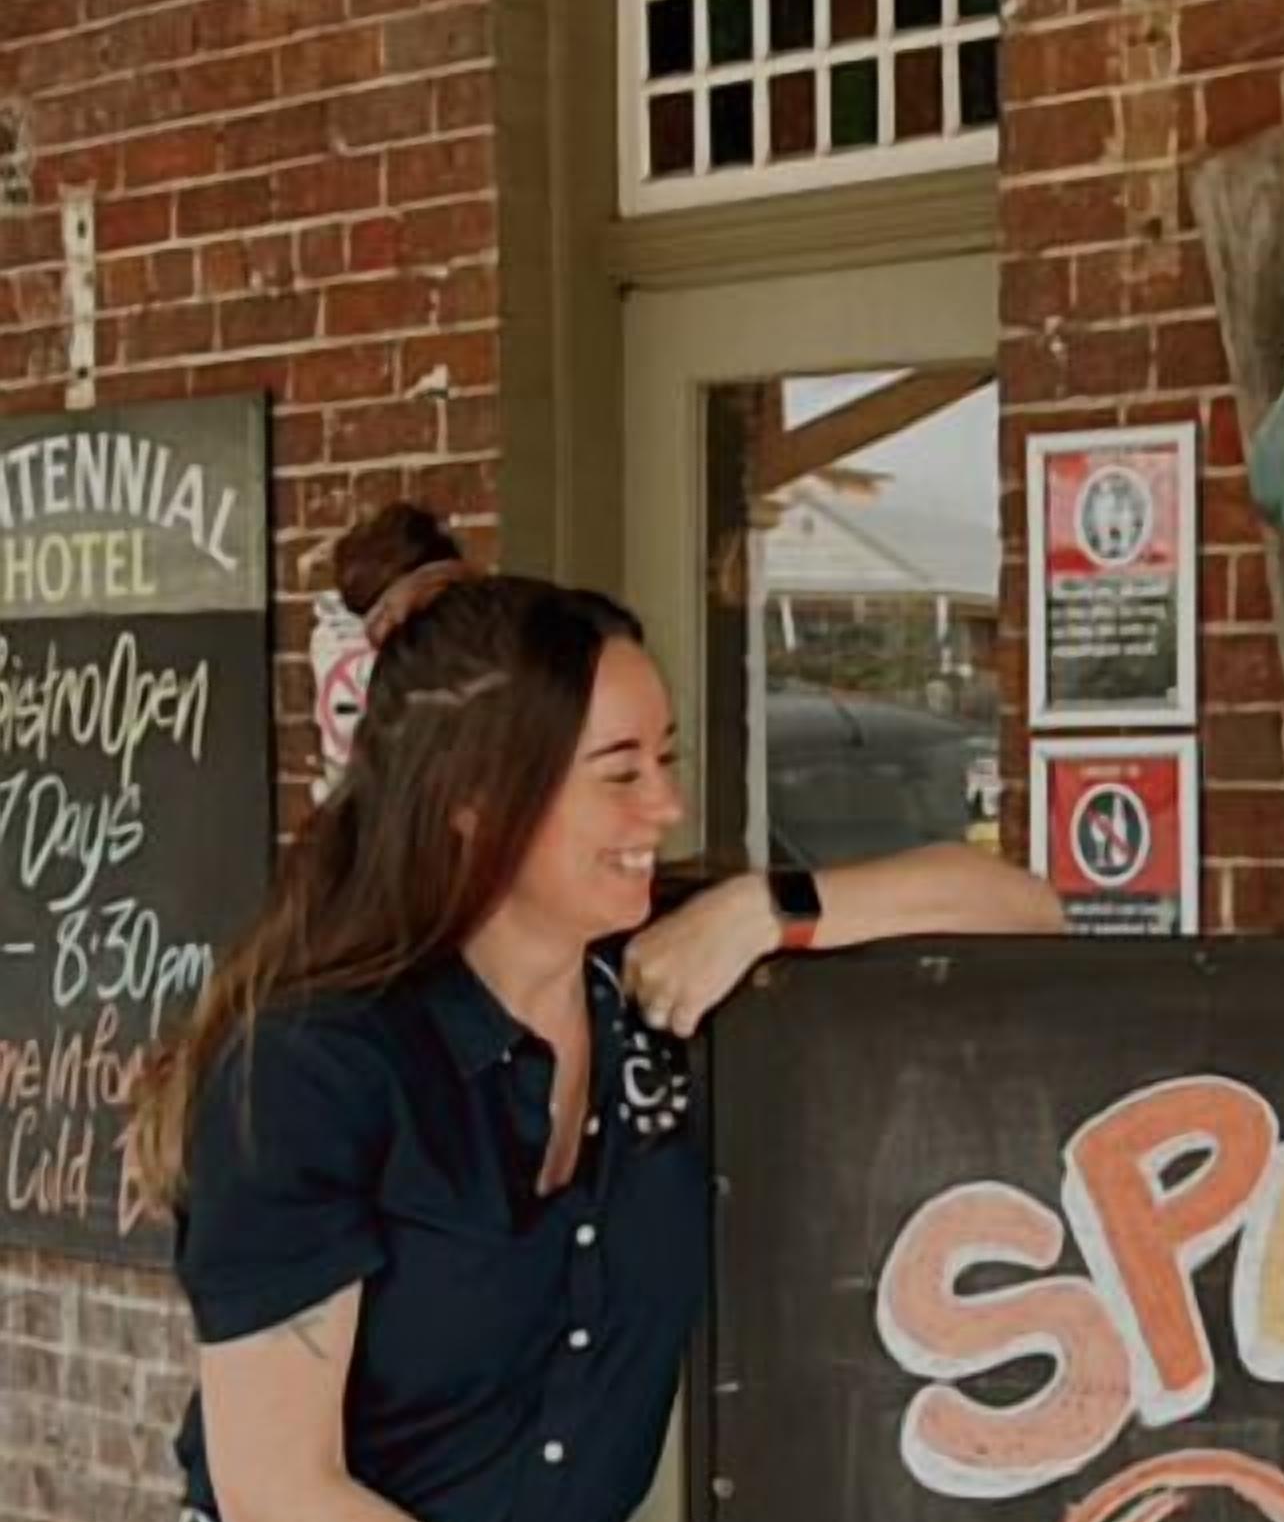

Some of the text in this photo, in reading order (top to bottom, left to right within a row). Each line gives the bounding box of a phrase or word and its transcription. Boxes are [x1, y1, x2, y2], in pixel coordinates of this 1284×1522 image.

[3, 529, 156, 603] HOTEL
[101, 632, 208, 788] Open
[21, 774, 144, 912] Days
